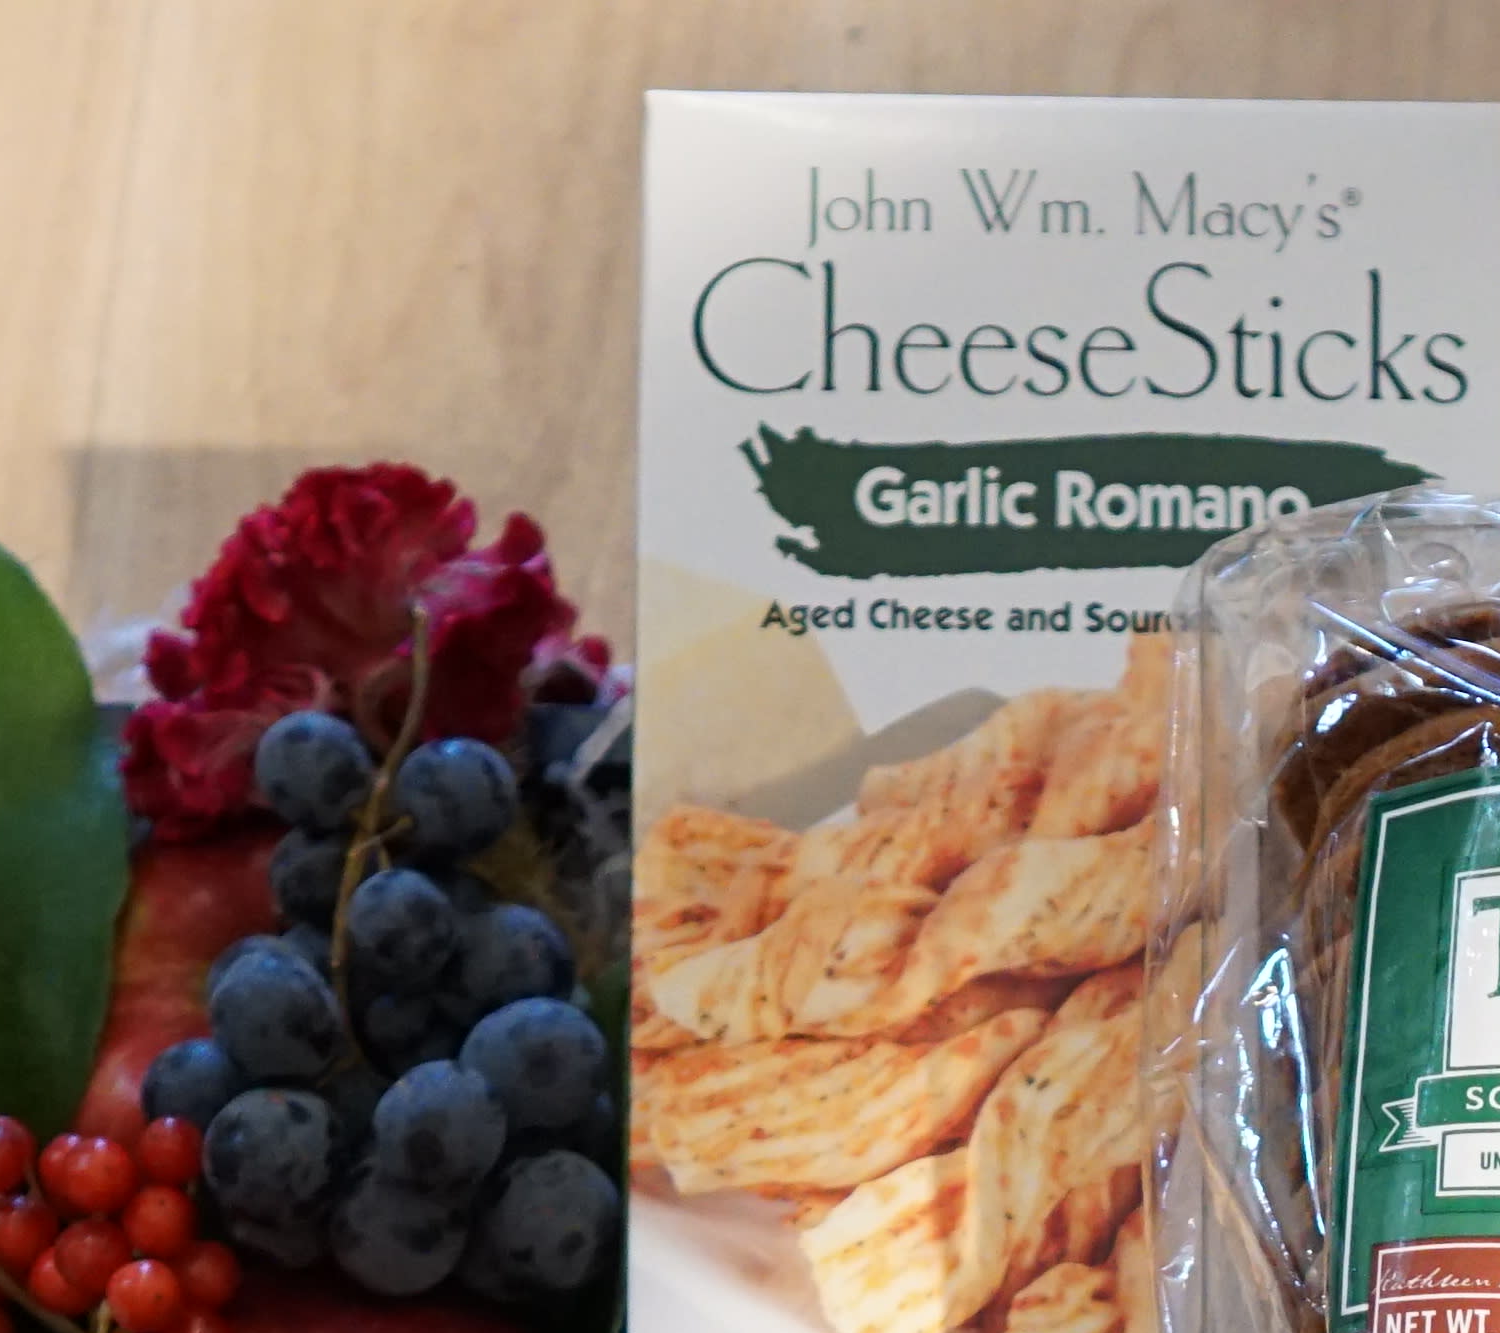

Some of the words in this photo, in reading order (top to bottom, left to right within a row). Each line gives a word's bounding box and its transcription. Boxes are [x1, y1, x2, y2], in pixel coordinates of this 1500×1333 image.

[806, 166, 932, 249] John
[960, 167, 1106, 236] Wm.
[691, 255, 1469, 403] CheeseSticks
[854, 466, 1039, 529] Garlic
[1054, 469, 1311, 530] Romano
[761, 598, 855, 636] Aged
[869, 599, 994, 632] Cheese
[1007, 601, 1073, 633] and
[1084, 601, 1172, 634] Sour
